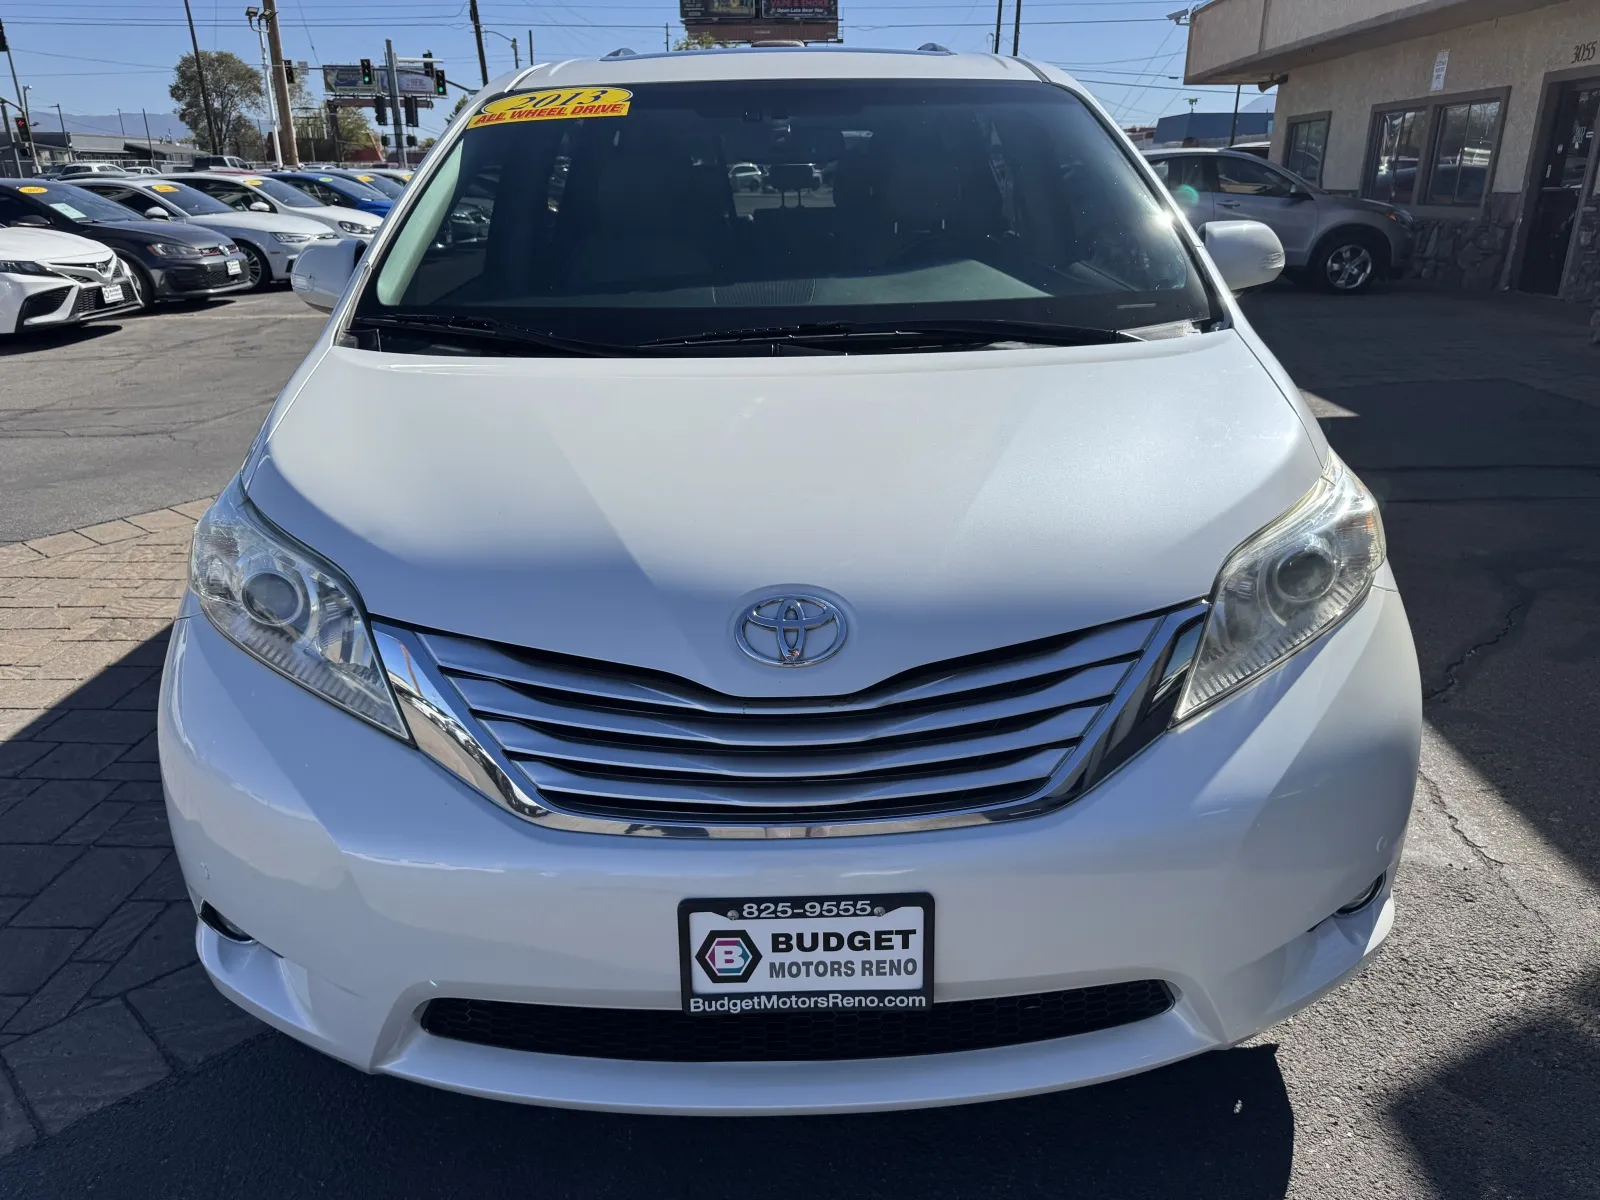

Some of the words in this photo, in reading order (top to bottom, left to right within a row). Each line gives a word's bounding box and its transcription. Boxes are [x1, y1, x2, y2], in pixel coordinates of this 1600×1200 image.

[1571, 40, 1598, 64] 3055
[503, 89, 608, 110] 2013
[473, 113, 506, 126] ALL
[509, 107, 568, 120] WHEEL
[570, 103, 623, 115] DRIVE
[742, 900, 872, 919] 825-9555
[771, 929, 917, 953] BUDGET
[769, 960, 856, 979] MOTORS
[861, 957, 918, 977] RENO
[689, 993, 927, 1014] BudgetMotorsReno.com
